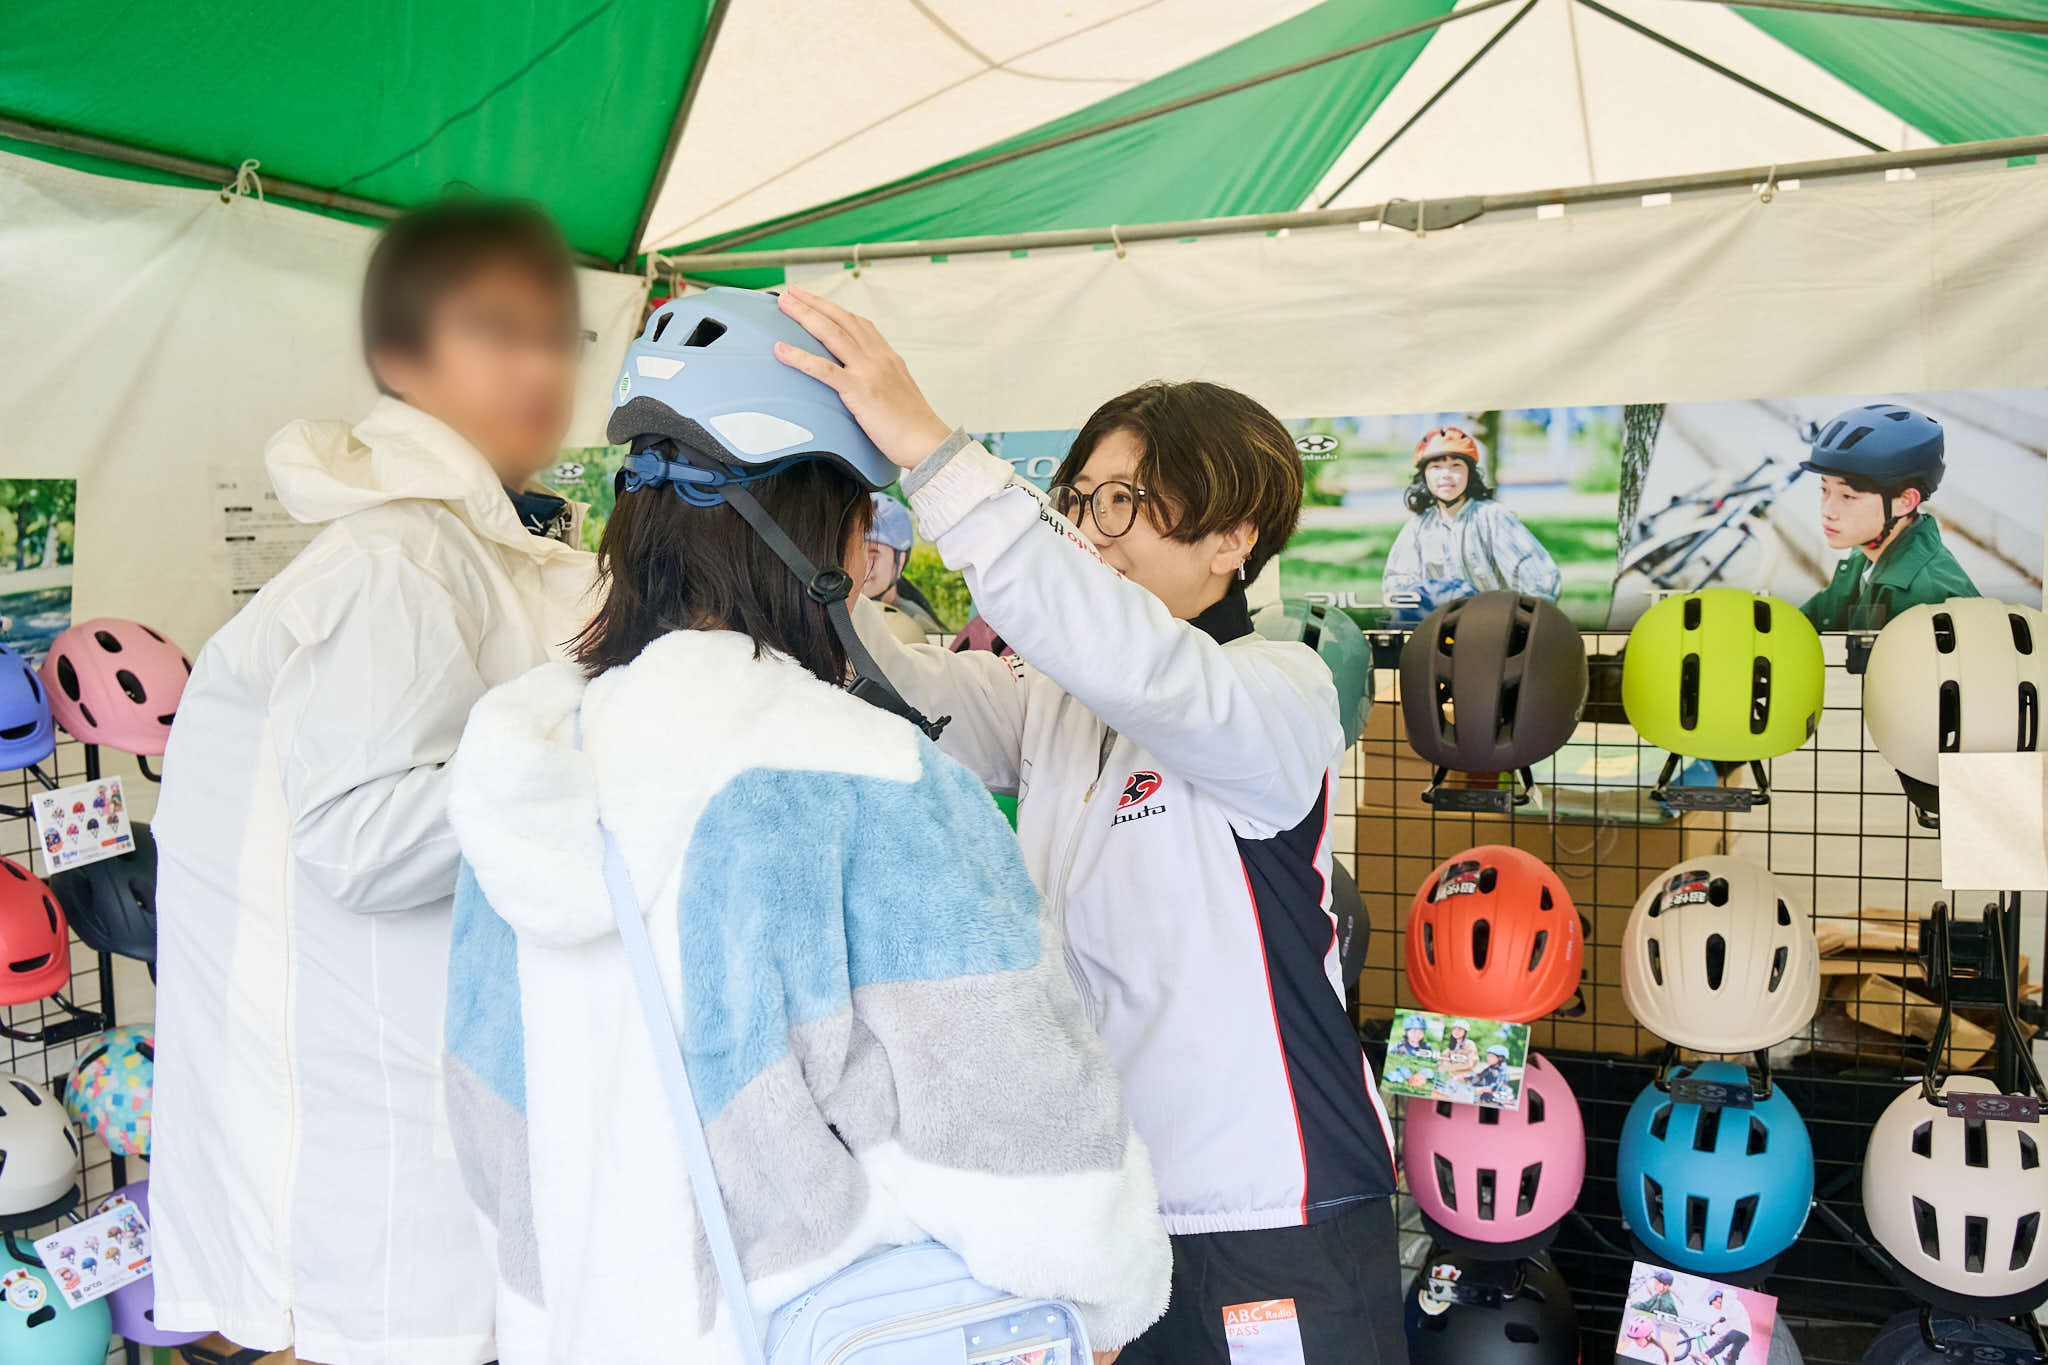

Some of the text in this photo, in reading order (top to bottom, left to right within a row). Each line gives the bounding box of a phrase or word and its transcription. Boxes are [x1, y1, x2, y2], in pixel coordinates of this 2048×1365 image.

[1039, 511, 1066, 537] the
[1110, 804, 1168, 828] buto
[1226, 1307, 1293, 1324] ABC Radio
[1228, 1325, 1261, 1338] PASS
